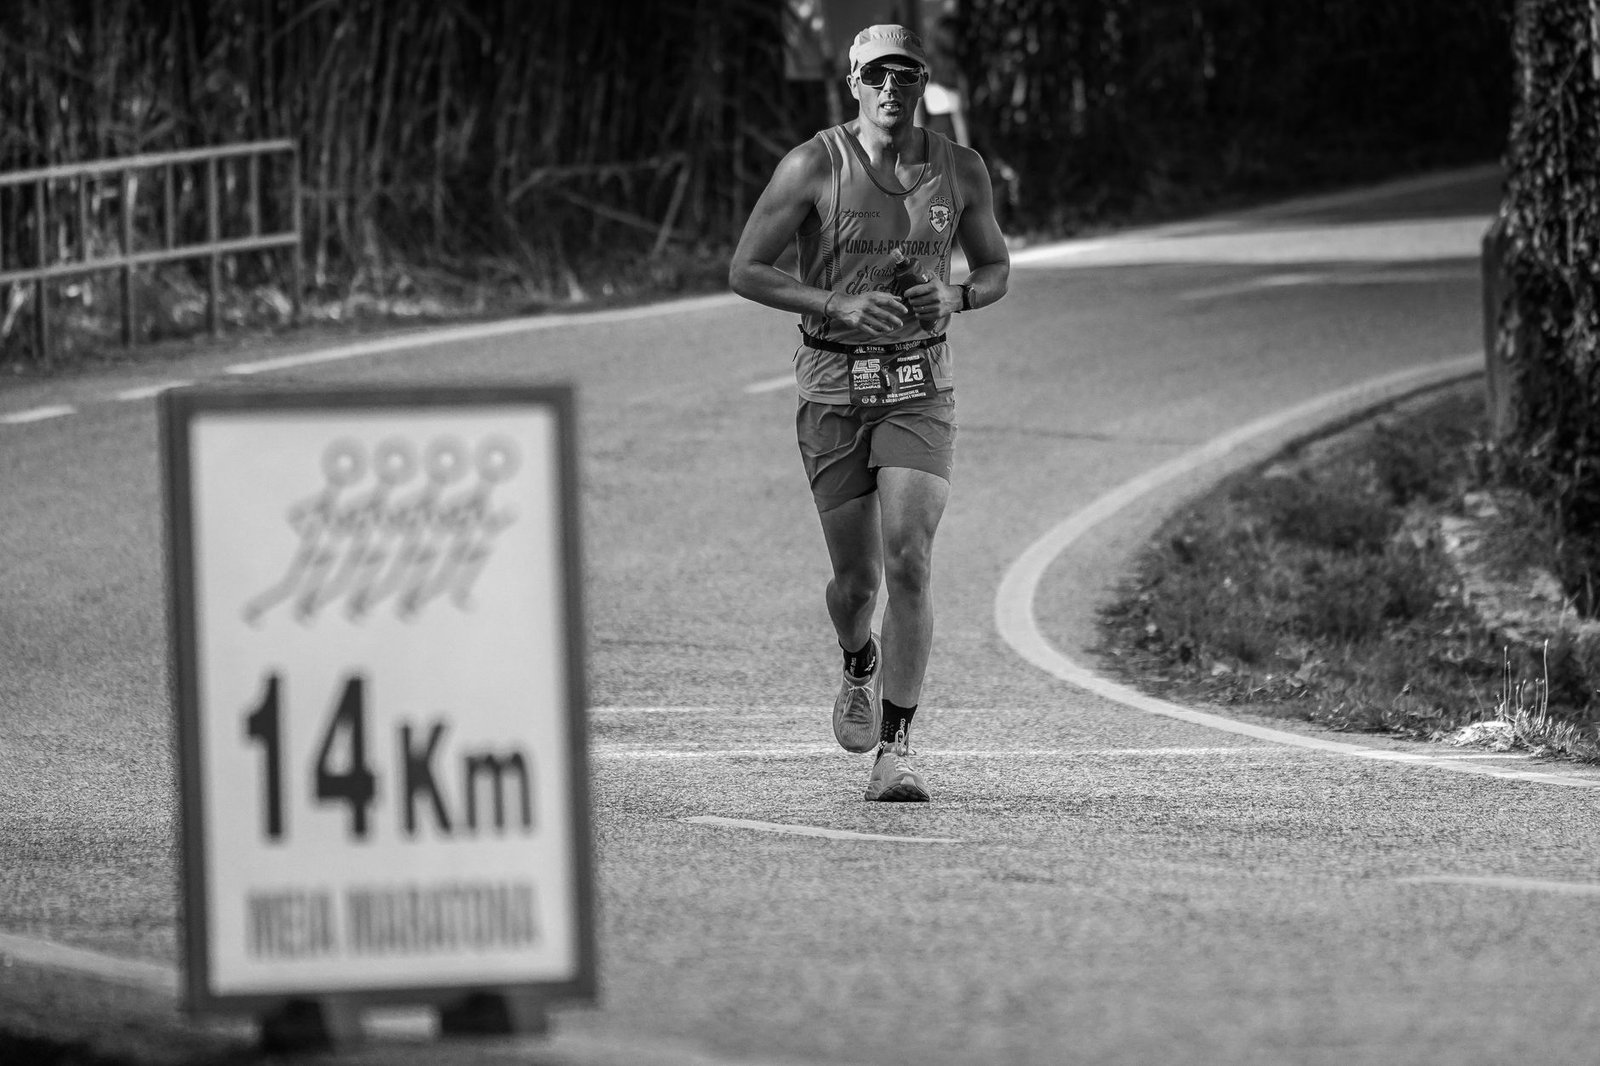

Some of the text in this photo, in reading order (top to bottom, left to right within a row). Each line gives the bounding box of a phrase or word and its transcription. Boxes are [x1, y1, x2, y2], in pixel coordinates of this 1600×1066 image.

[853, 372, 880, 381] MEIA
[895, 364, 924, 383] 125
[243, 670, 534, 841] 14 Km
